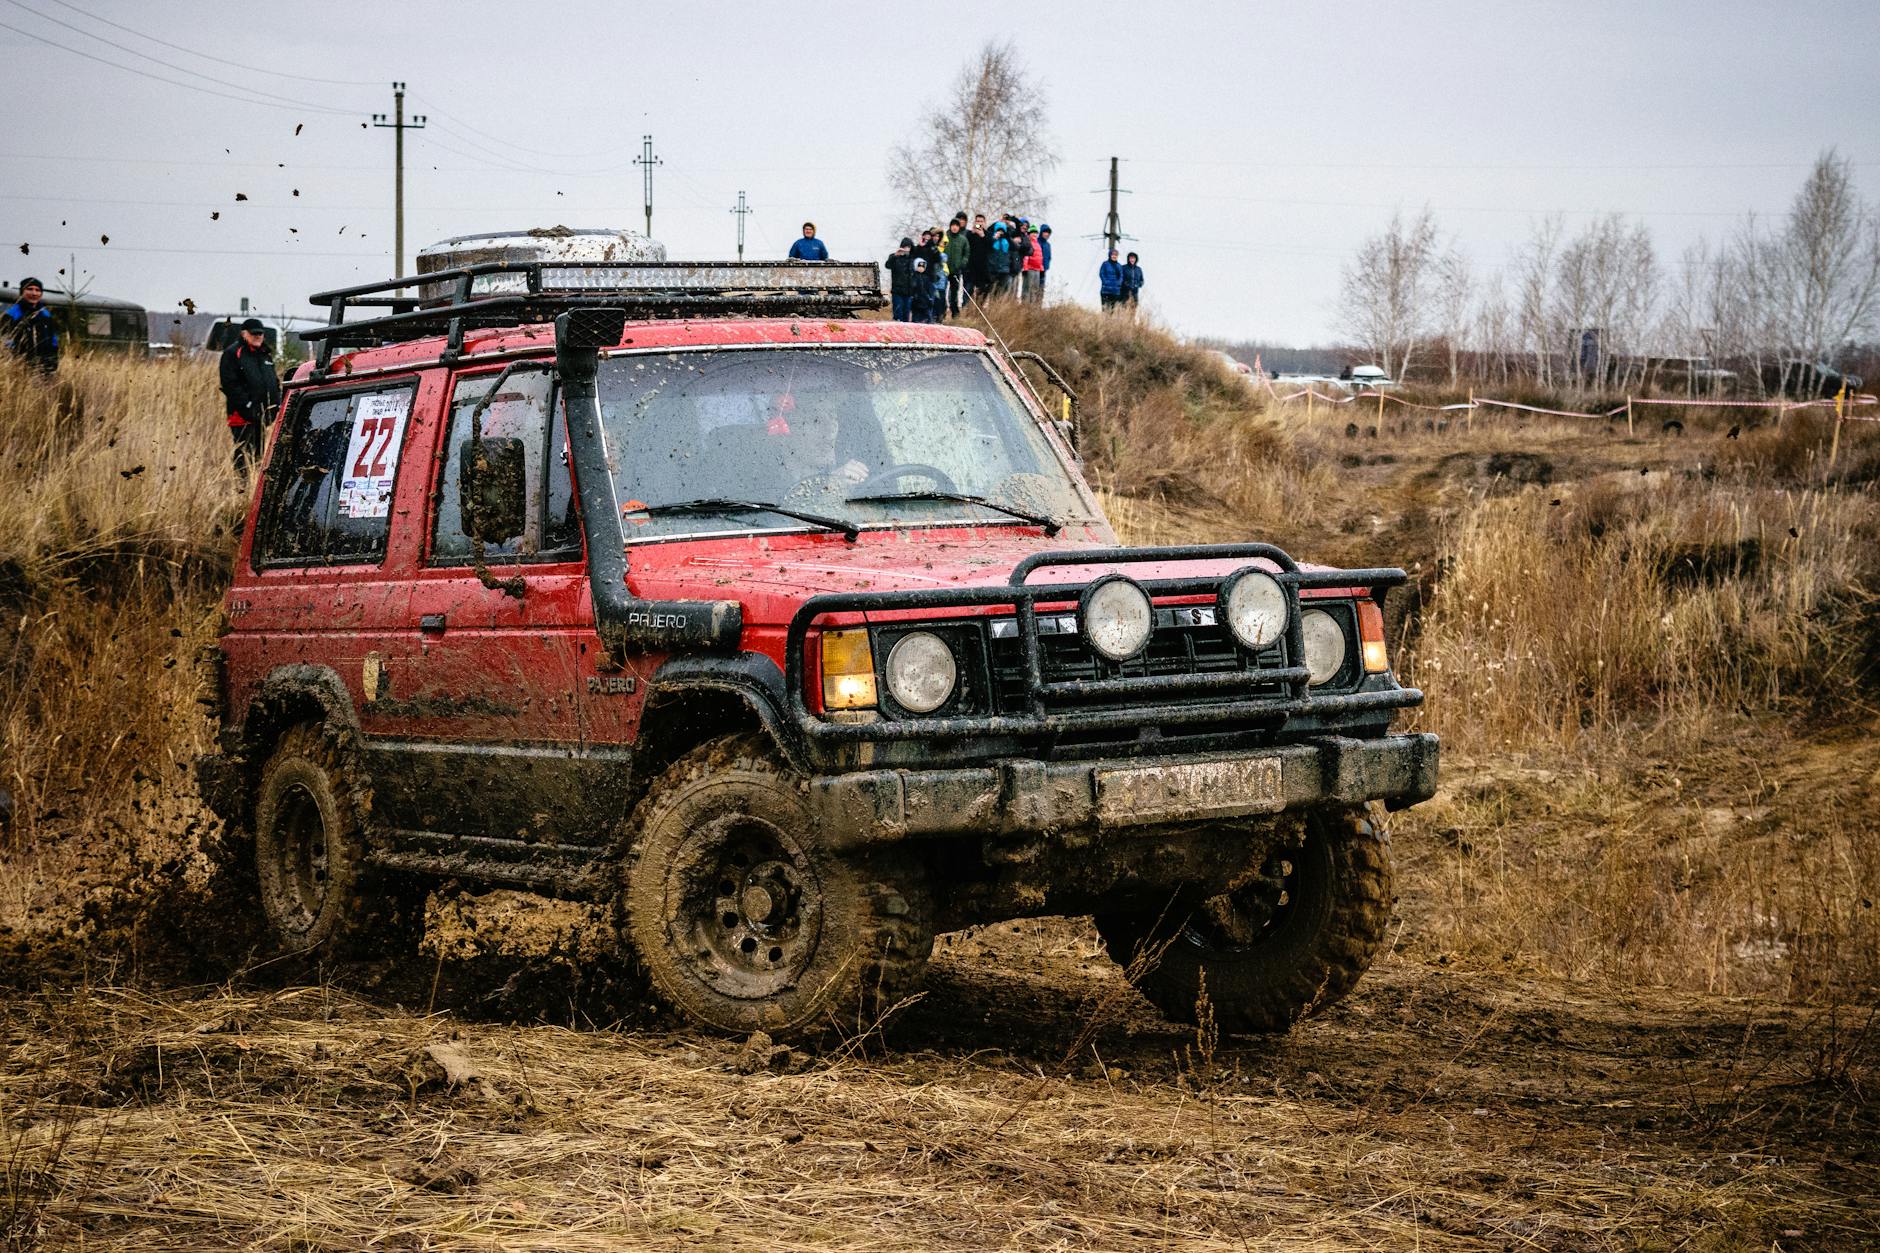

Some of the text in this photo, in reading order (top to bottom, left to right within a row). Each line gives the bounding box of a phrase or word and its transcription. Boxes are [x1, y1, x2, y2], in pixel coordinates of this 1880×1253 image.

[352, 417, 397, 477] 22
[629, 613, 687, 628] PAJERO
[587, 676, 635, 693] PAJERO
